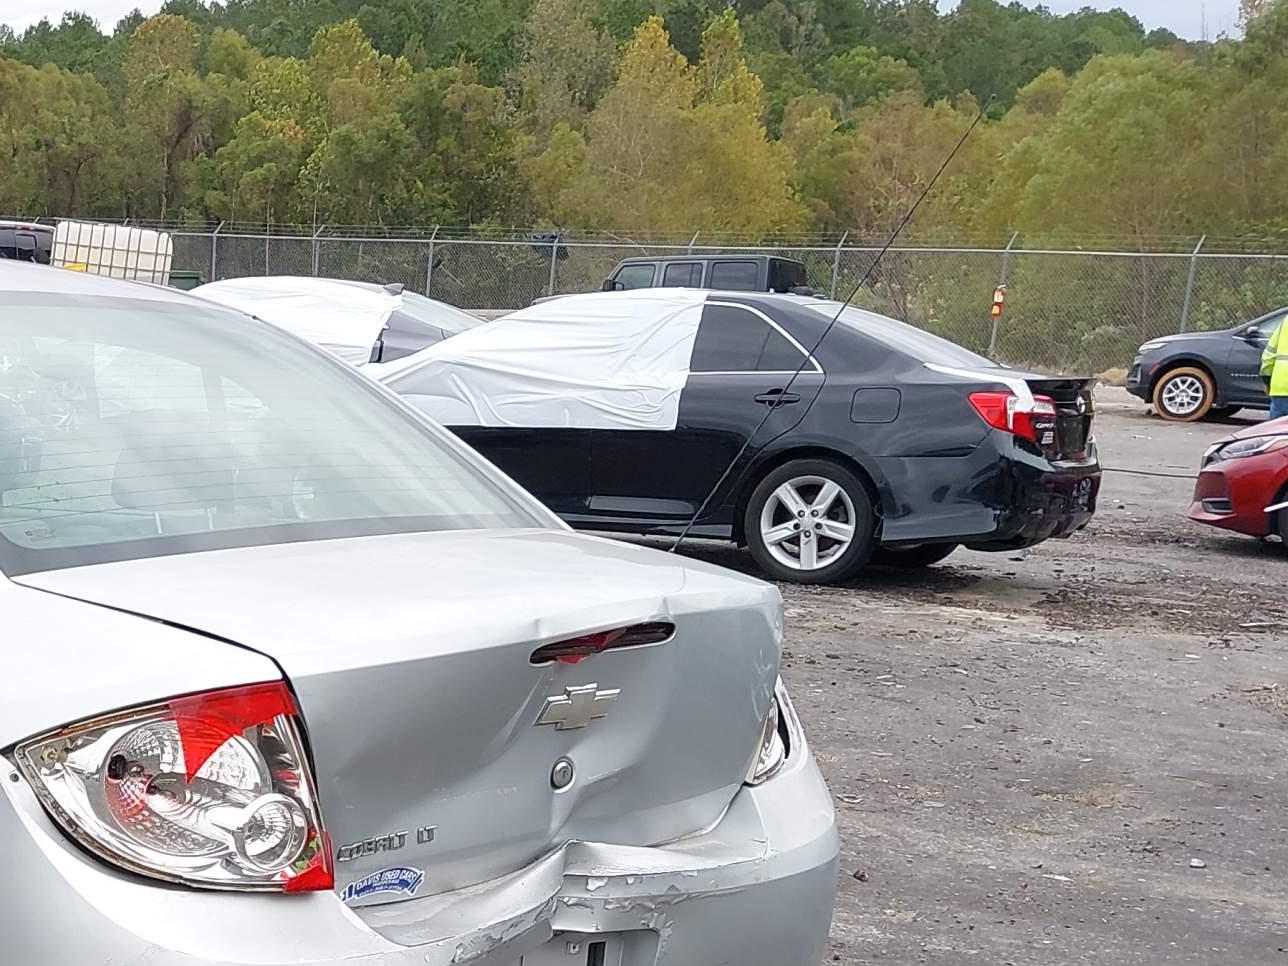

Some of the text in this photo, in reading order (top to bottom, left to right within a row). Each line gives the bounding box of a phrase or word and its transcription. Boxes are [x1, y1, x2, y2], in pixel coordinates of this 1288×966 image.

[336, 824, 438, 862] COBALT LT
[356, 873, 381, 890] DAVIS
[381, 869, 400, 882] USED
